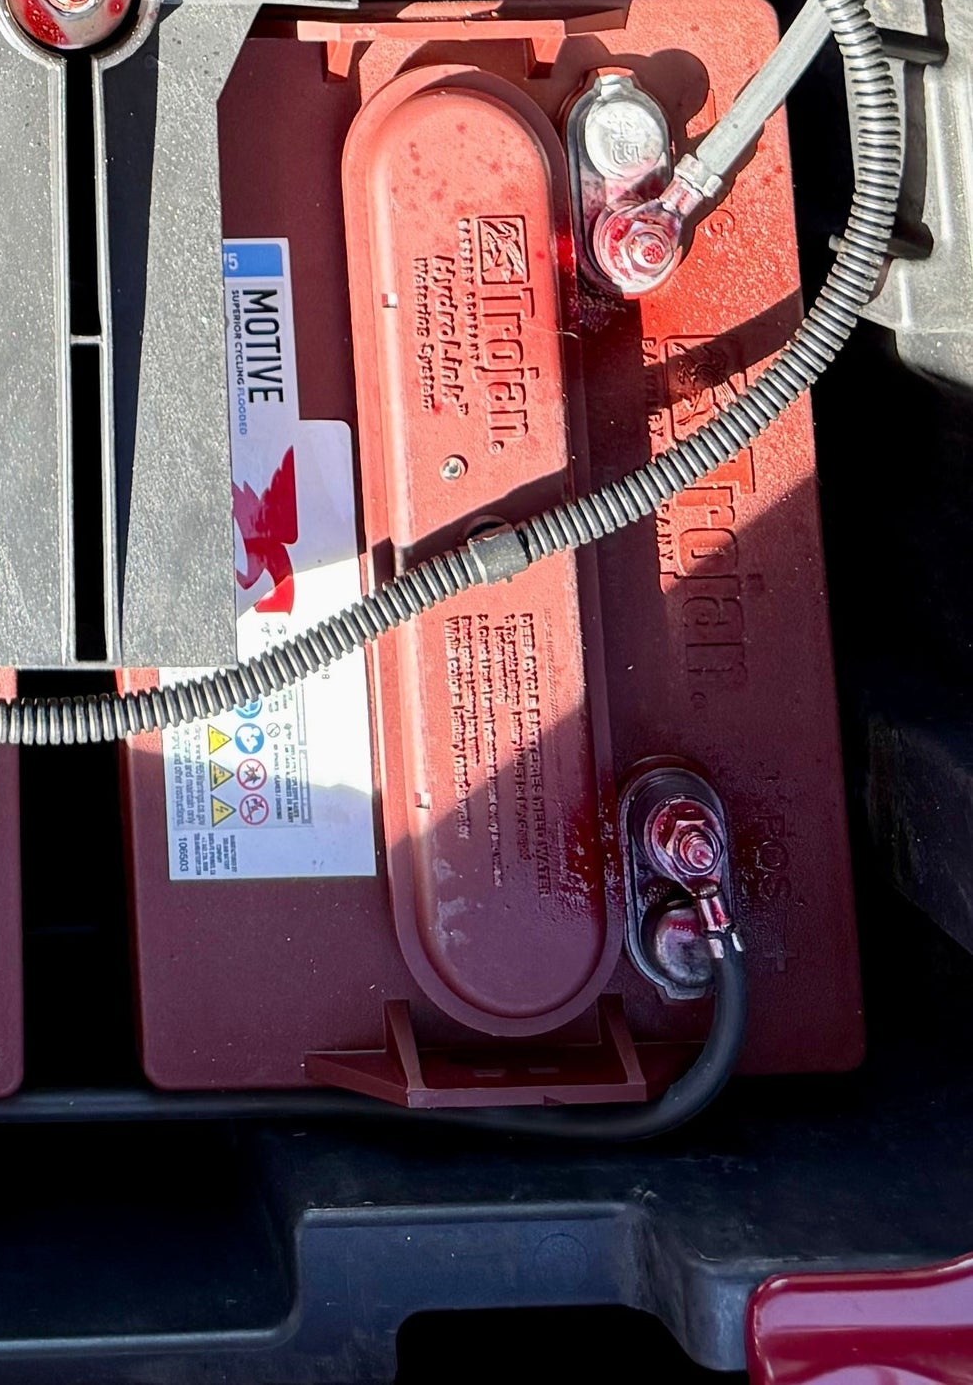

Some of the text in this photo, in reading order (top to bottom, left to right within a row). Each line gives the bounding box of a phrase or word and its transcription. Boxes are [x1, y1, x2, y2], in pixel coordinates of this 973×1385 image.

[232, 290, 247, 435] SUPERIOR CYCLING FLOODED
[242, 289, 284, 403] MOTIVE
[416, 344, 435, 413] System
[520, 613, 534, 652] DEEP
[523, 655, 538, 708] CYCLE
[174, 768, 183, 784] other
[525, 709, 543, 793] BATTERIES
[185, 779, 195, 809] maintain
[186, 810, 195, 824] only
[178, 837, 188, 872] 106503
[535, 843, 551, 897] WATER
